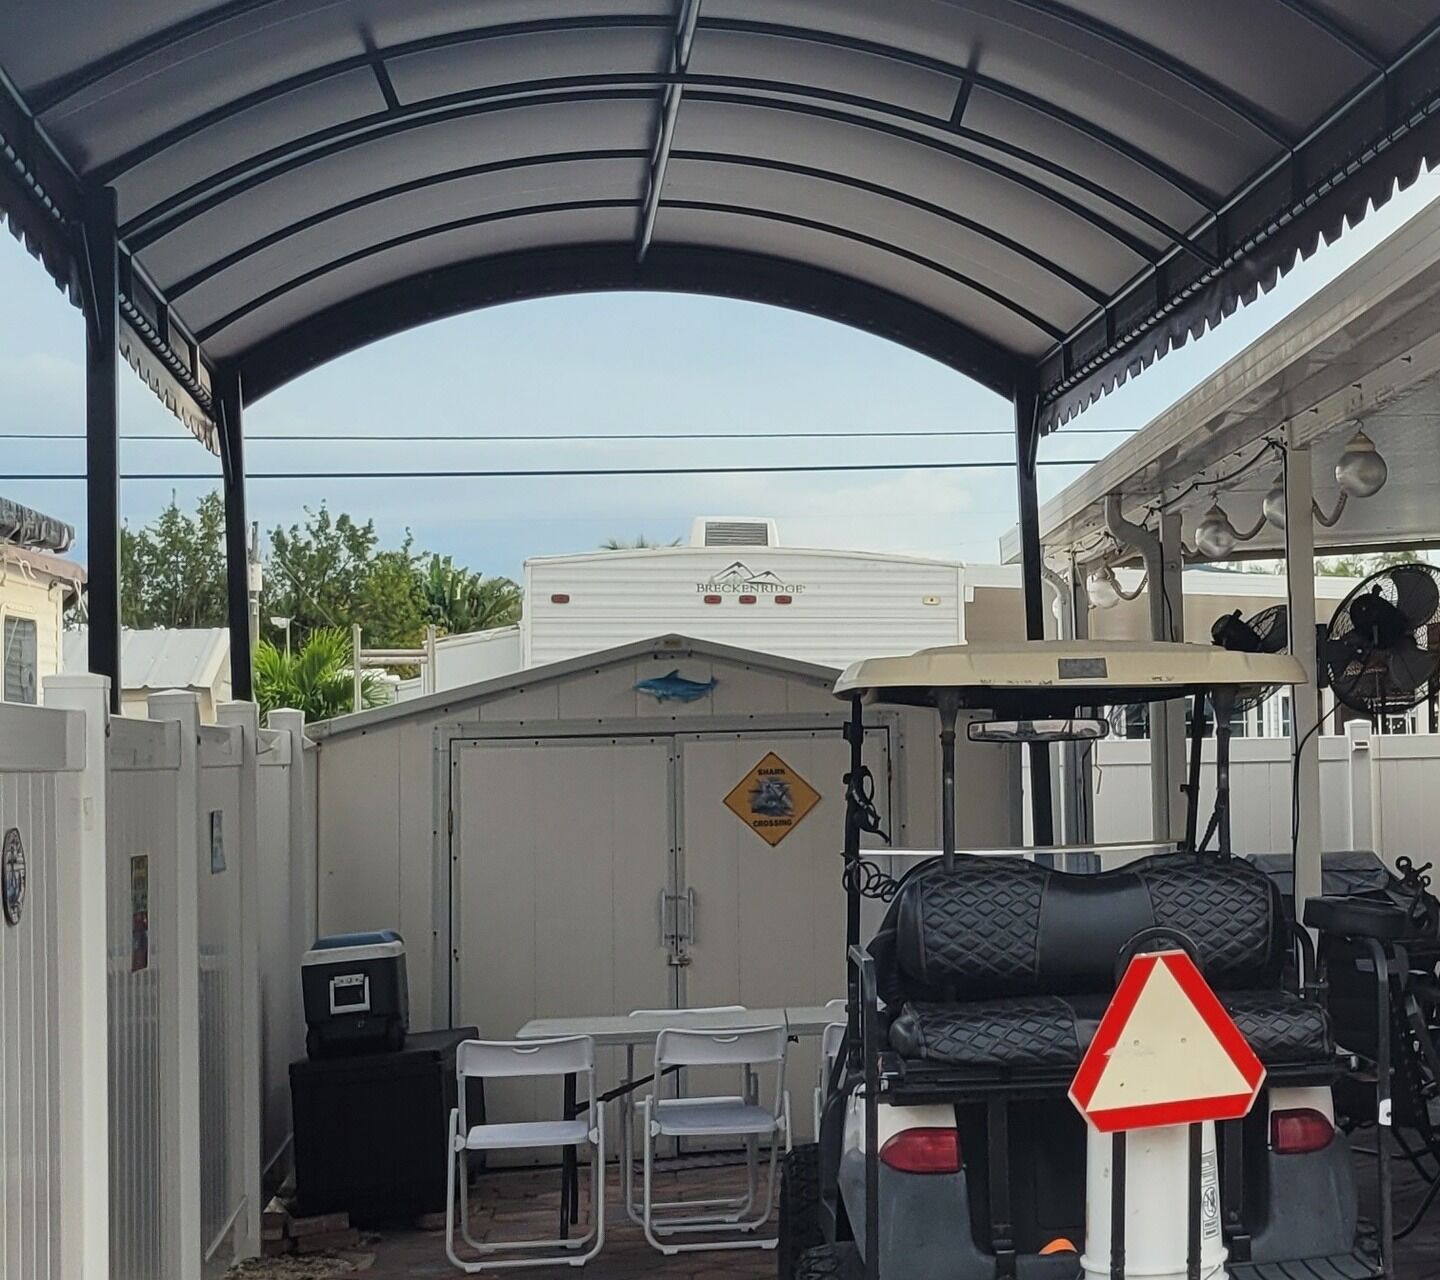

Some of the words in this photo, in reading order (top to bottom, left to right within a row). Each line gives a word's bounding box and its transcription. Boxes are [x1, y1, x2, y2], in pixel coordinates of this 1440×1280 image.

[696, 583, 802, 593] BRECKENRIDGE
[758, 768, 785, 776] SHARK
[753, 819, 792, 828] CROSSING
